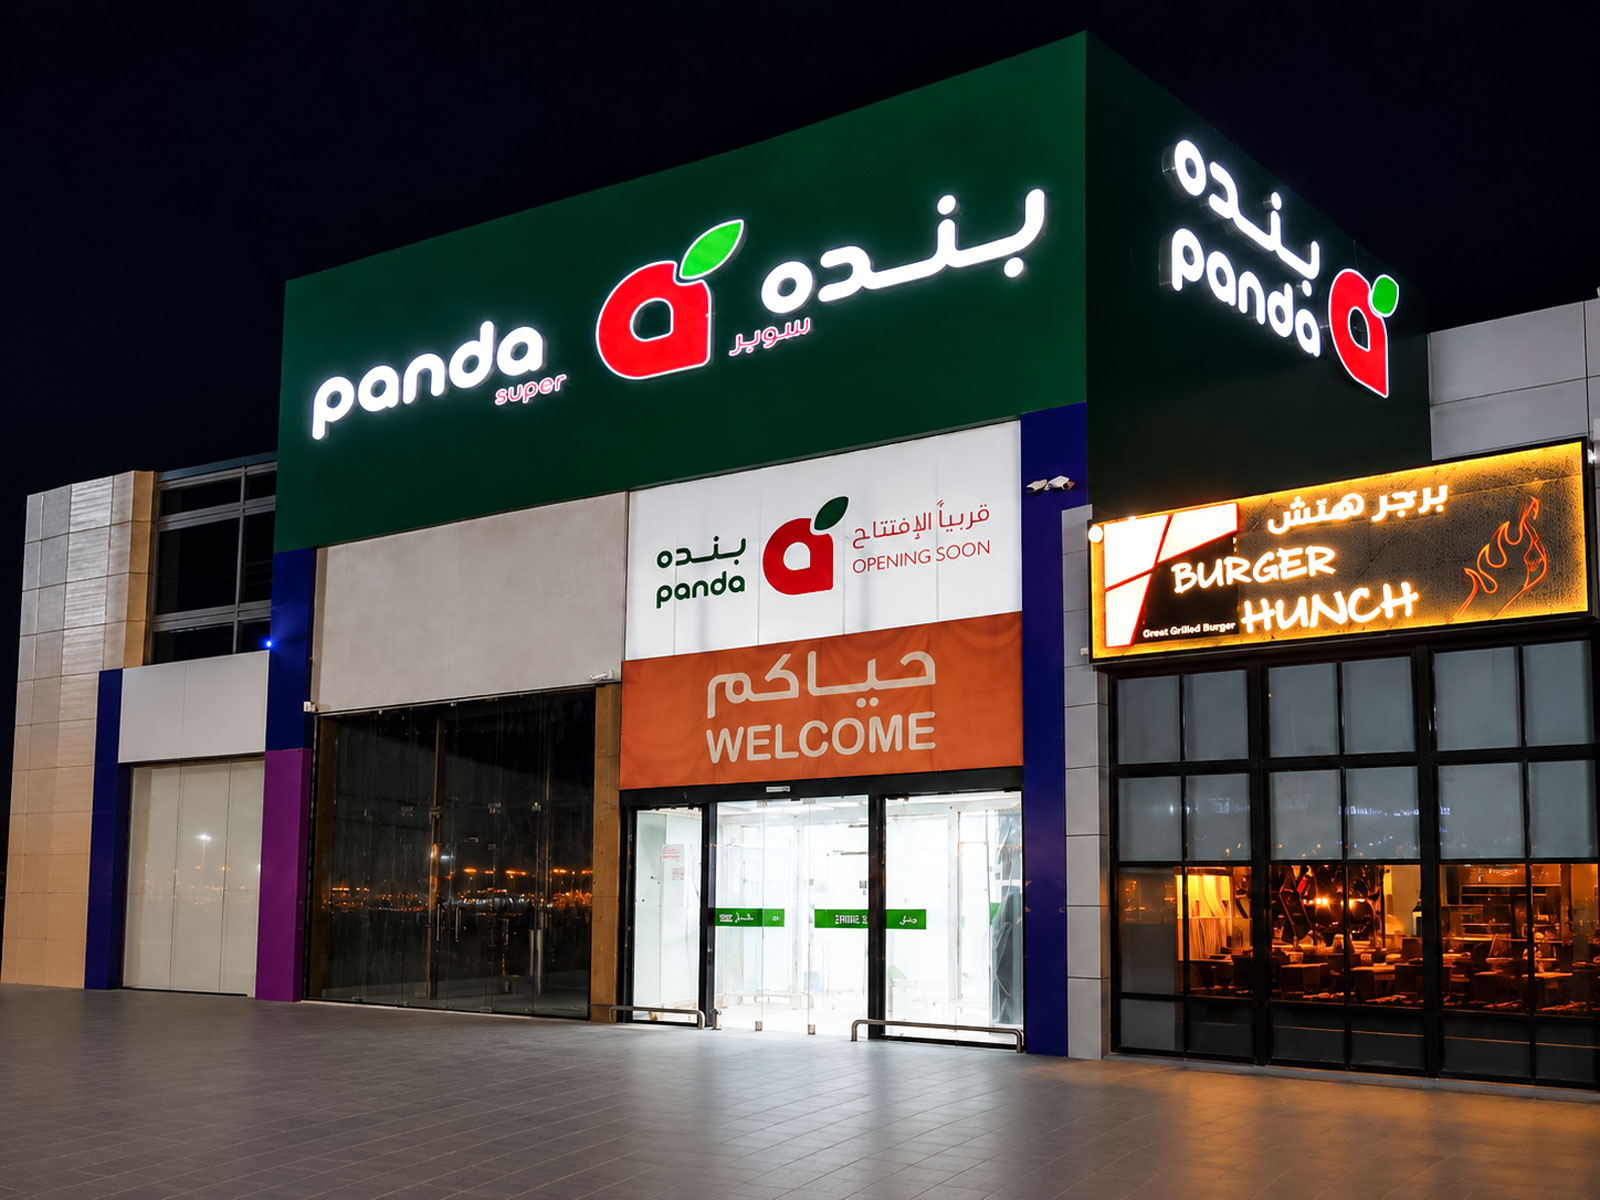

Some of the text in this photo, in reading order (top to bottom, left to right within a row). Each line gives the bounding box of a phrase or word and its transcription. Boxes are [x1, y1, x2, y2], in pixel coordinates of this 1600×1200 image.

[1172, 139, 1320, 297] بنده
[761, 188, 1045, 314] بنده
[1171, 228, 1321, 357] panda
[728, 316, 812, 357] سوبر
[312, 320, 544, 440] panda
[494, 374, 567, 406] super
[1371, 484, 1448, 523] برجر
[656, 535, 747, 569] بنده
[852, 540, 991, 574] OPENING SOON
[1170, 545, 1336, 594] BURGER
[655, 570, 746, 609] panda
[1240, 581, 1419, 634] HUNCH
[1142, 621, 1236, 638] Great Grilled Burger
[706, 650, 937, 719] حياكم
[705, 711, 937, 764] WELCOME
